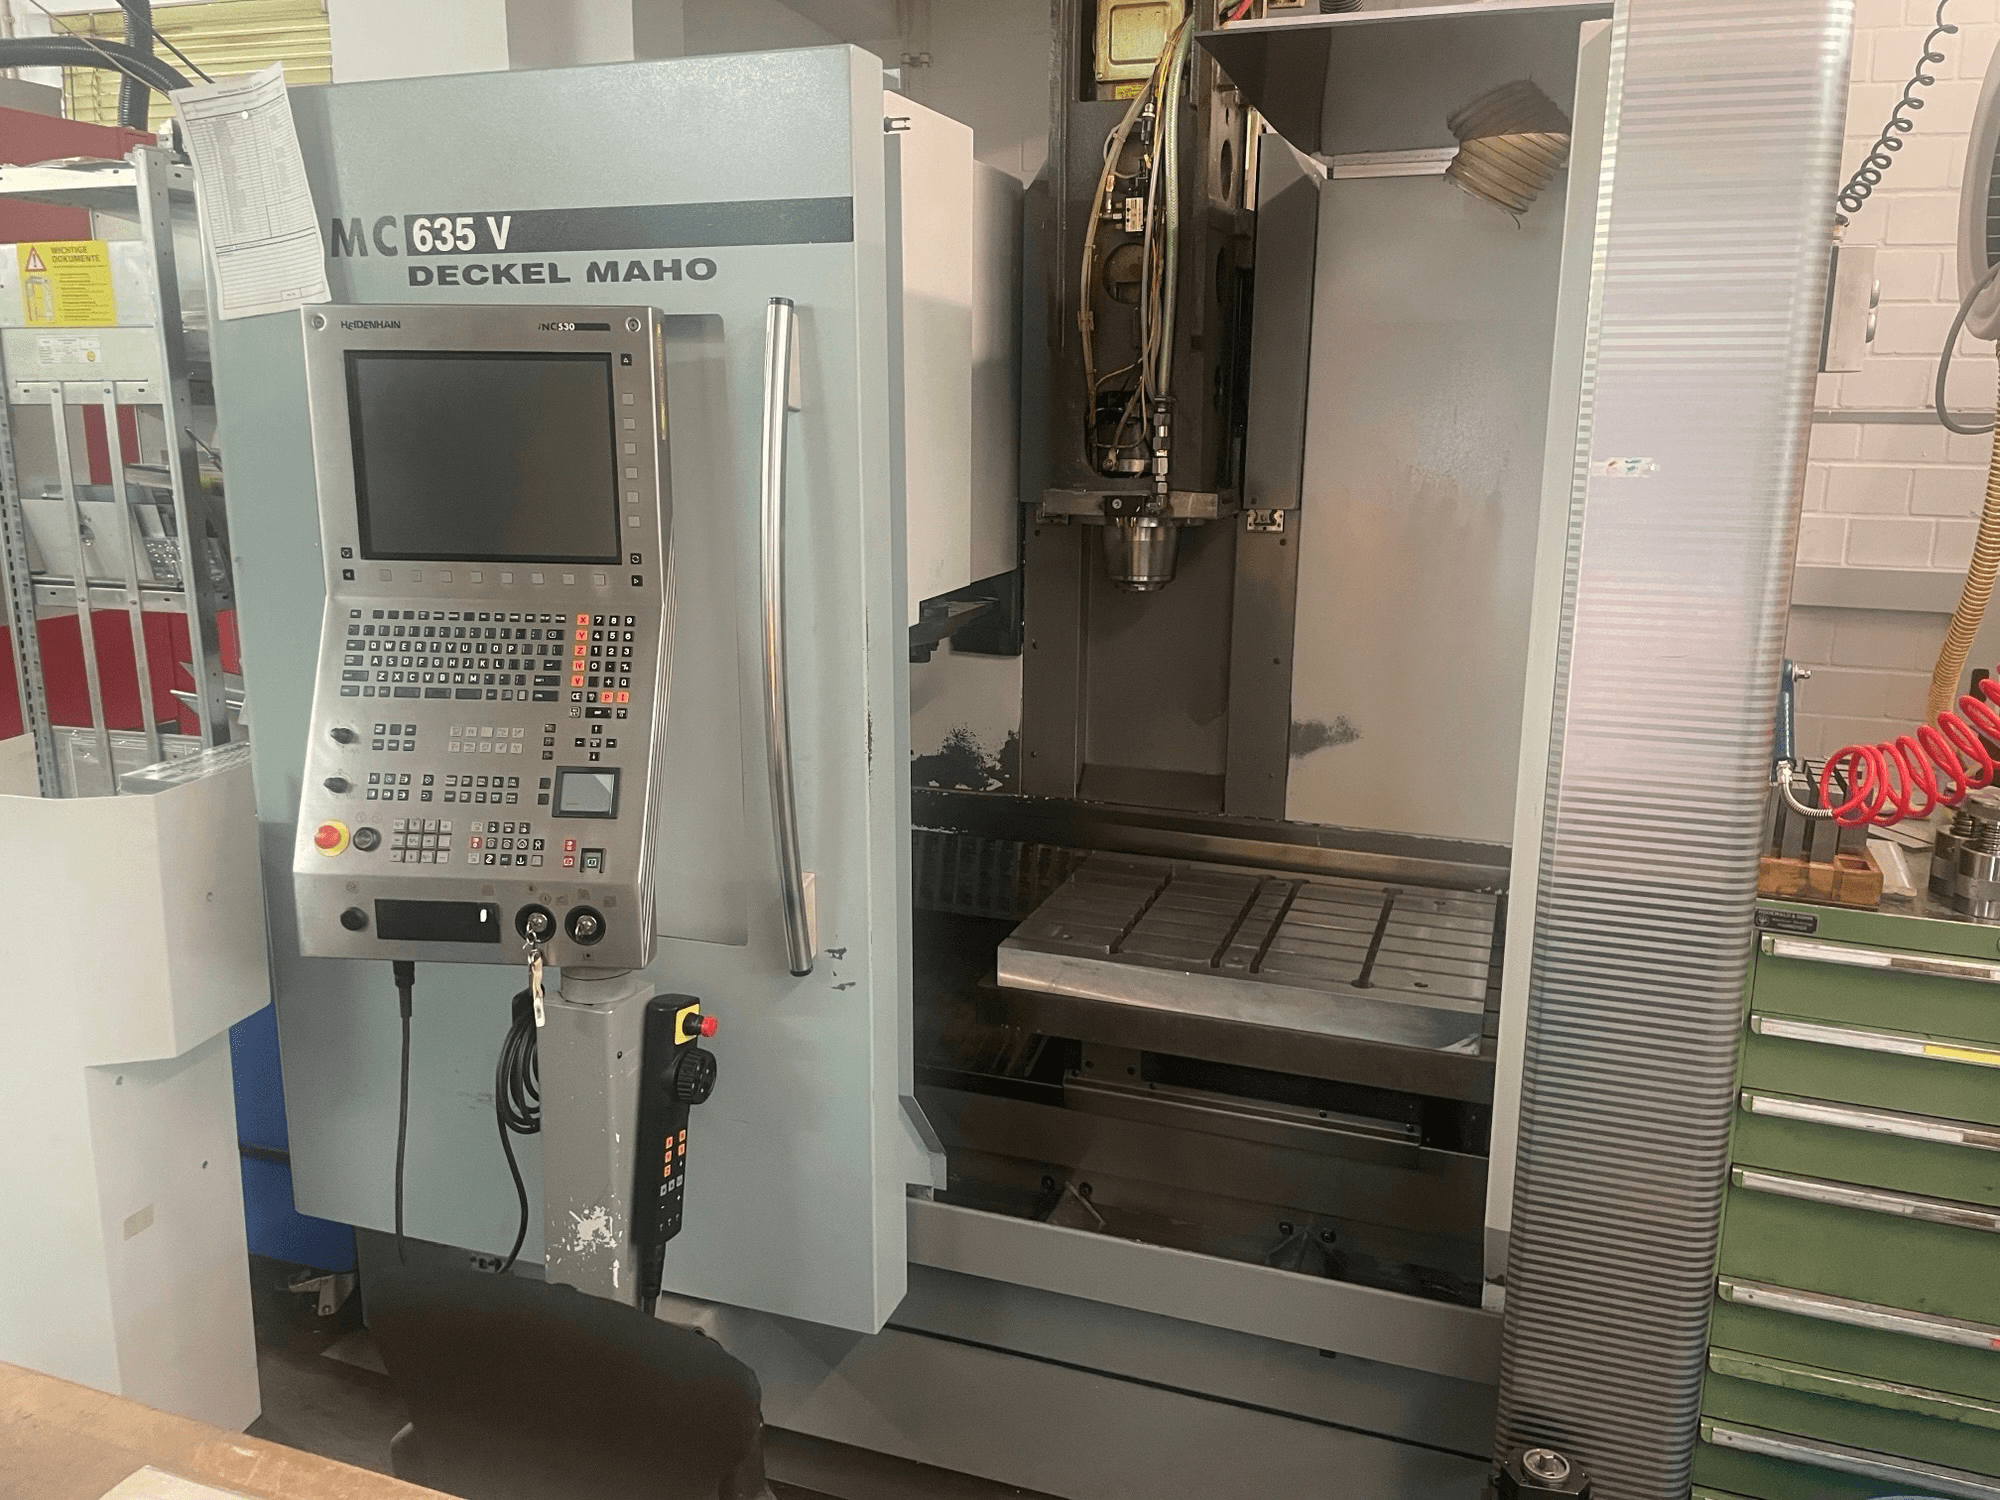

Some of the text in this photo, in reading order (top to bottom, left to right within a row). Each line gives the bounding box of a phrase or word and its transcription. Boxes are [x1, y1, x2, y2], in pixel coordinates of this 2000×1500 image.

[412, 216, 477, 253] 635
[486, 215, 511, 250] V
[408, 257, 718, 287] DECKEL MAHO
[340, 320, 401, 331] HEIDENHAIN
